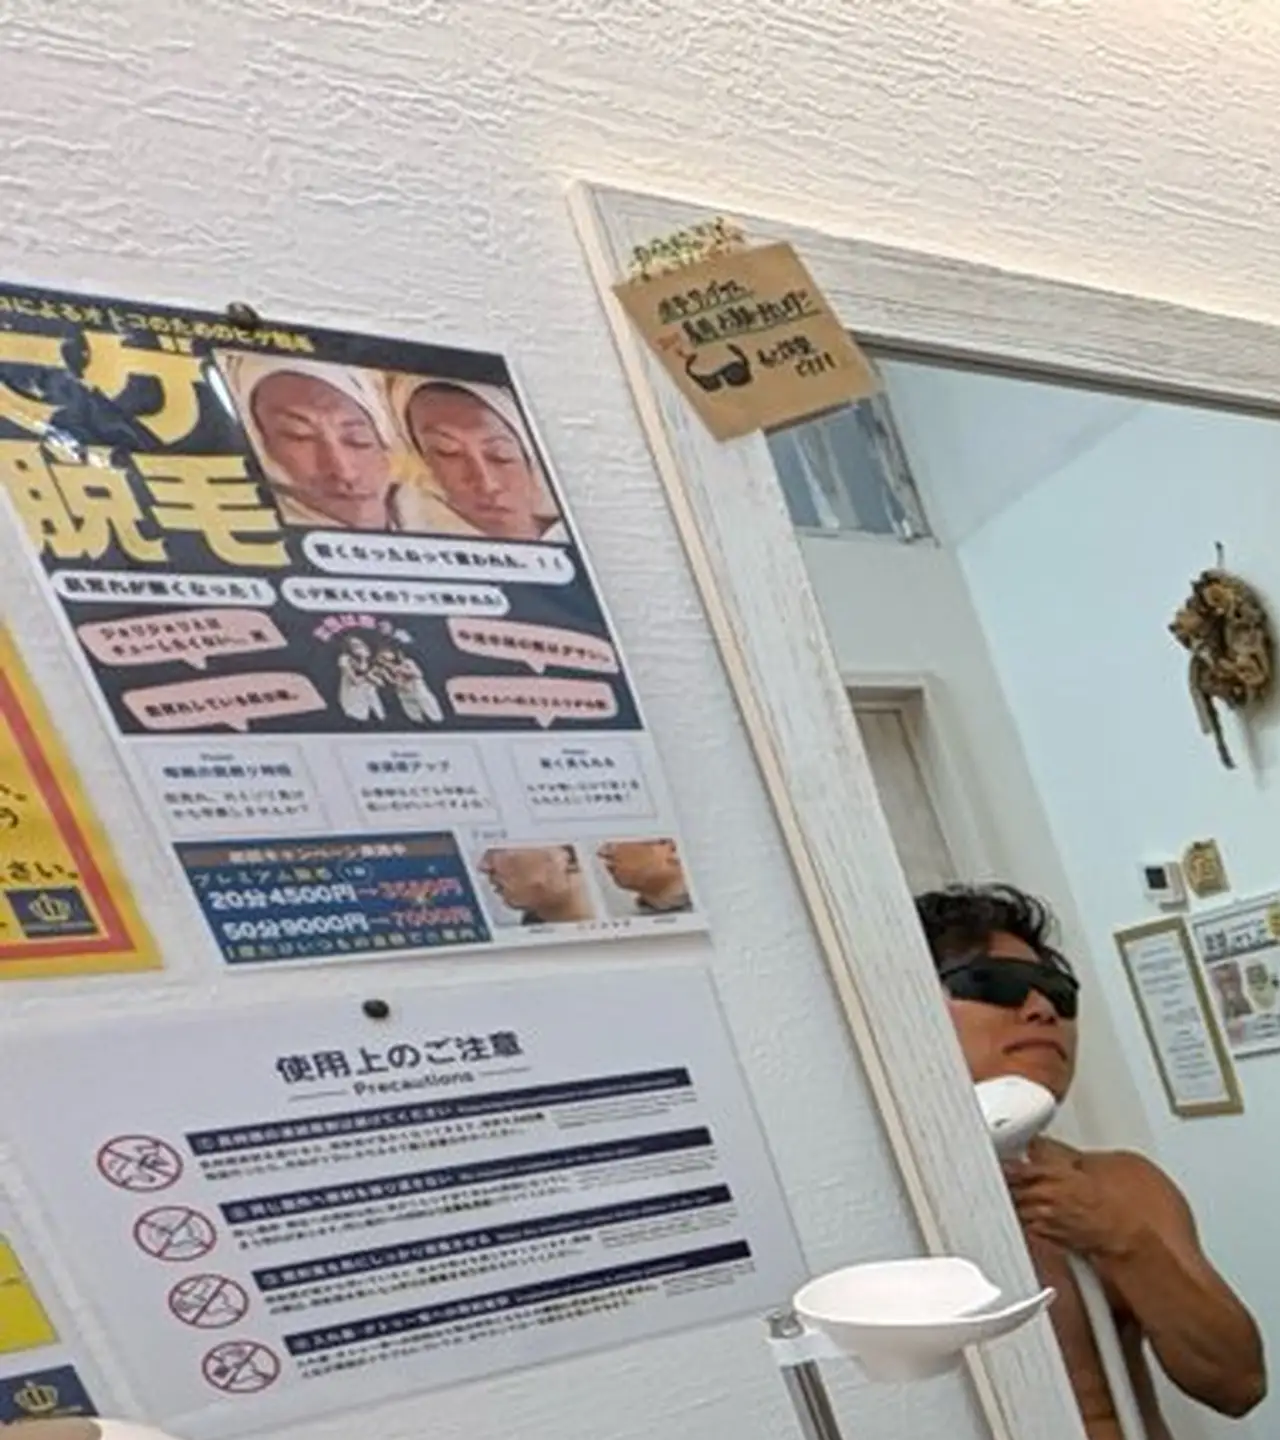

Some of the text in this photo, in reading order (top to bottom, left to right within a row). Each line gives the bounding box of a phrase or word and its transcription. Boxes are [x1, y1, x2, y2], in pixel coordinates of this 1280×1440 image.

[0, 438, 292, 566] 脱毛
[276, 1030, 525, 1085] 使用上のご注意
[352, 1070, 476, 1096] Precautions
